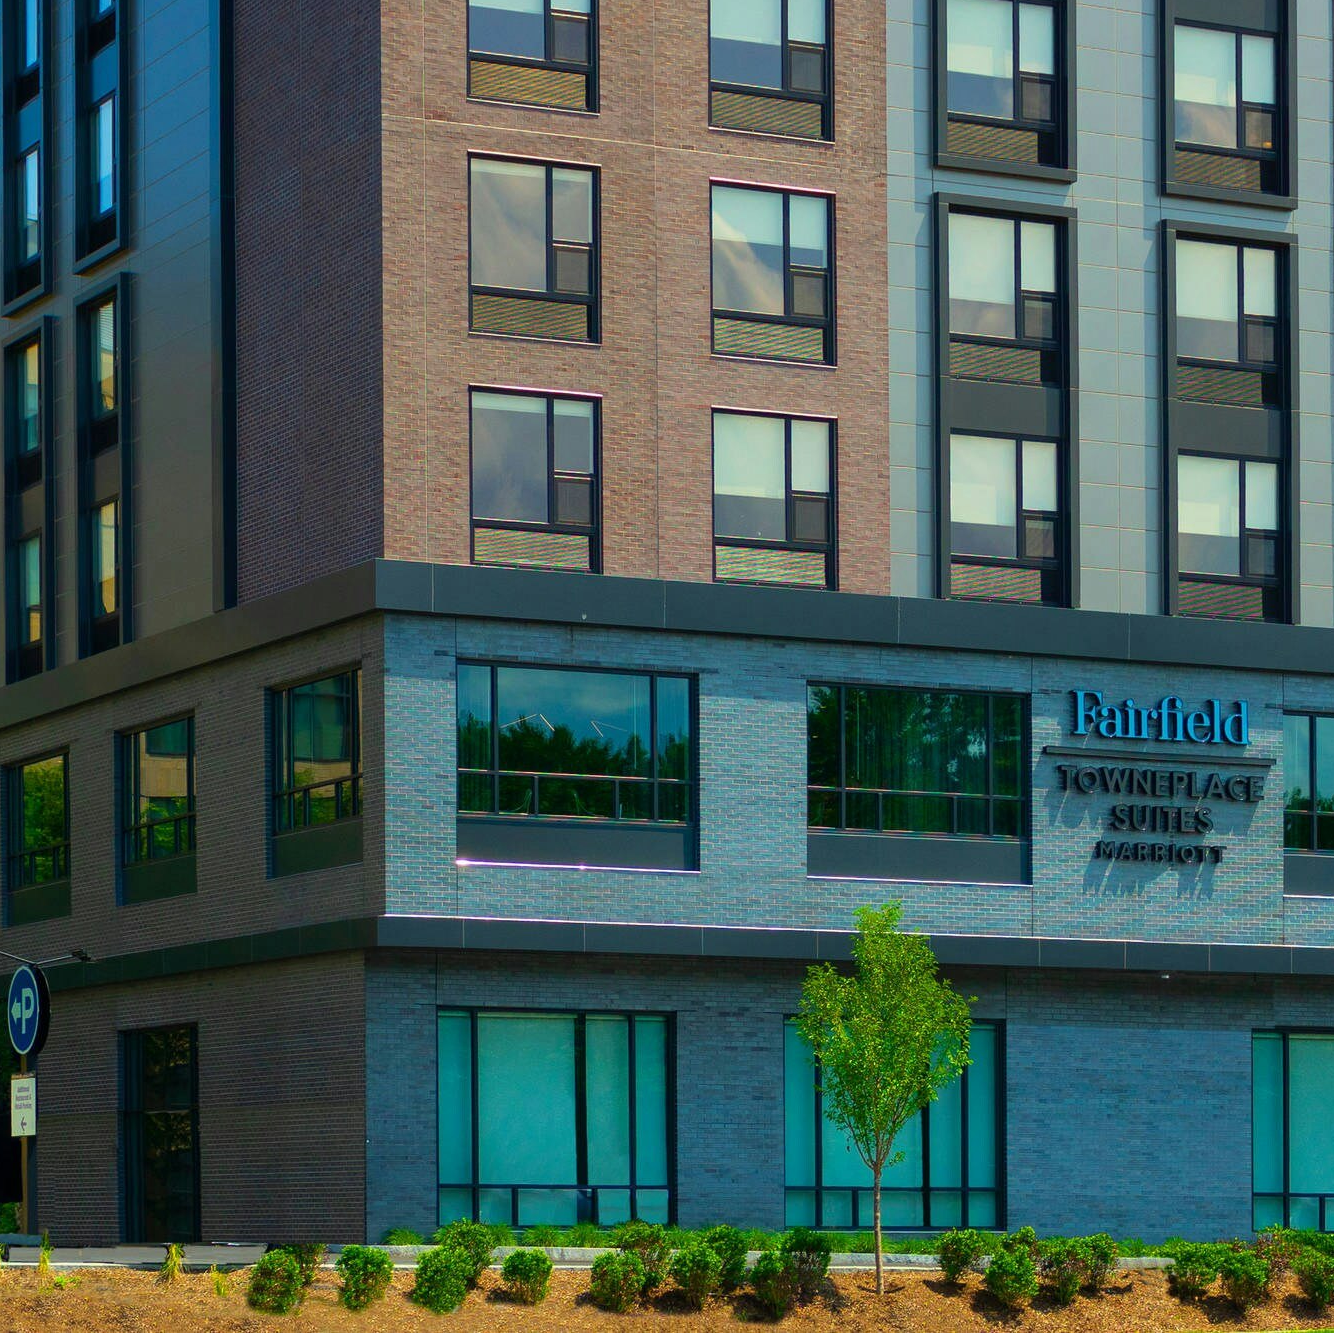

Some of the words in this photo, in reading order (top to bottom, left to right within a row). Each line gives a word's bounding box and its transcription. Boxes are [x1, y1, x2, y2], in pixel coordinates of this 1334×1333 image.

[1069, 689, 1252, 746] Fairfield
[1058, 764, 1265, 803] TOWNEPLACE
[1111, 804, 1214, 834] SUITES
[1096, 841, 1227, 864] MARRIOTT
[21, 987, 35, 1035] P
